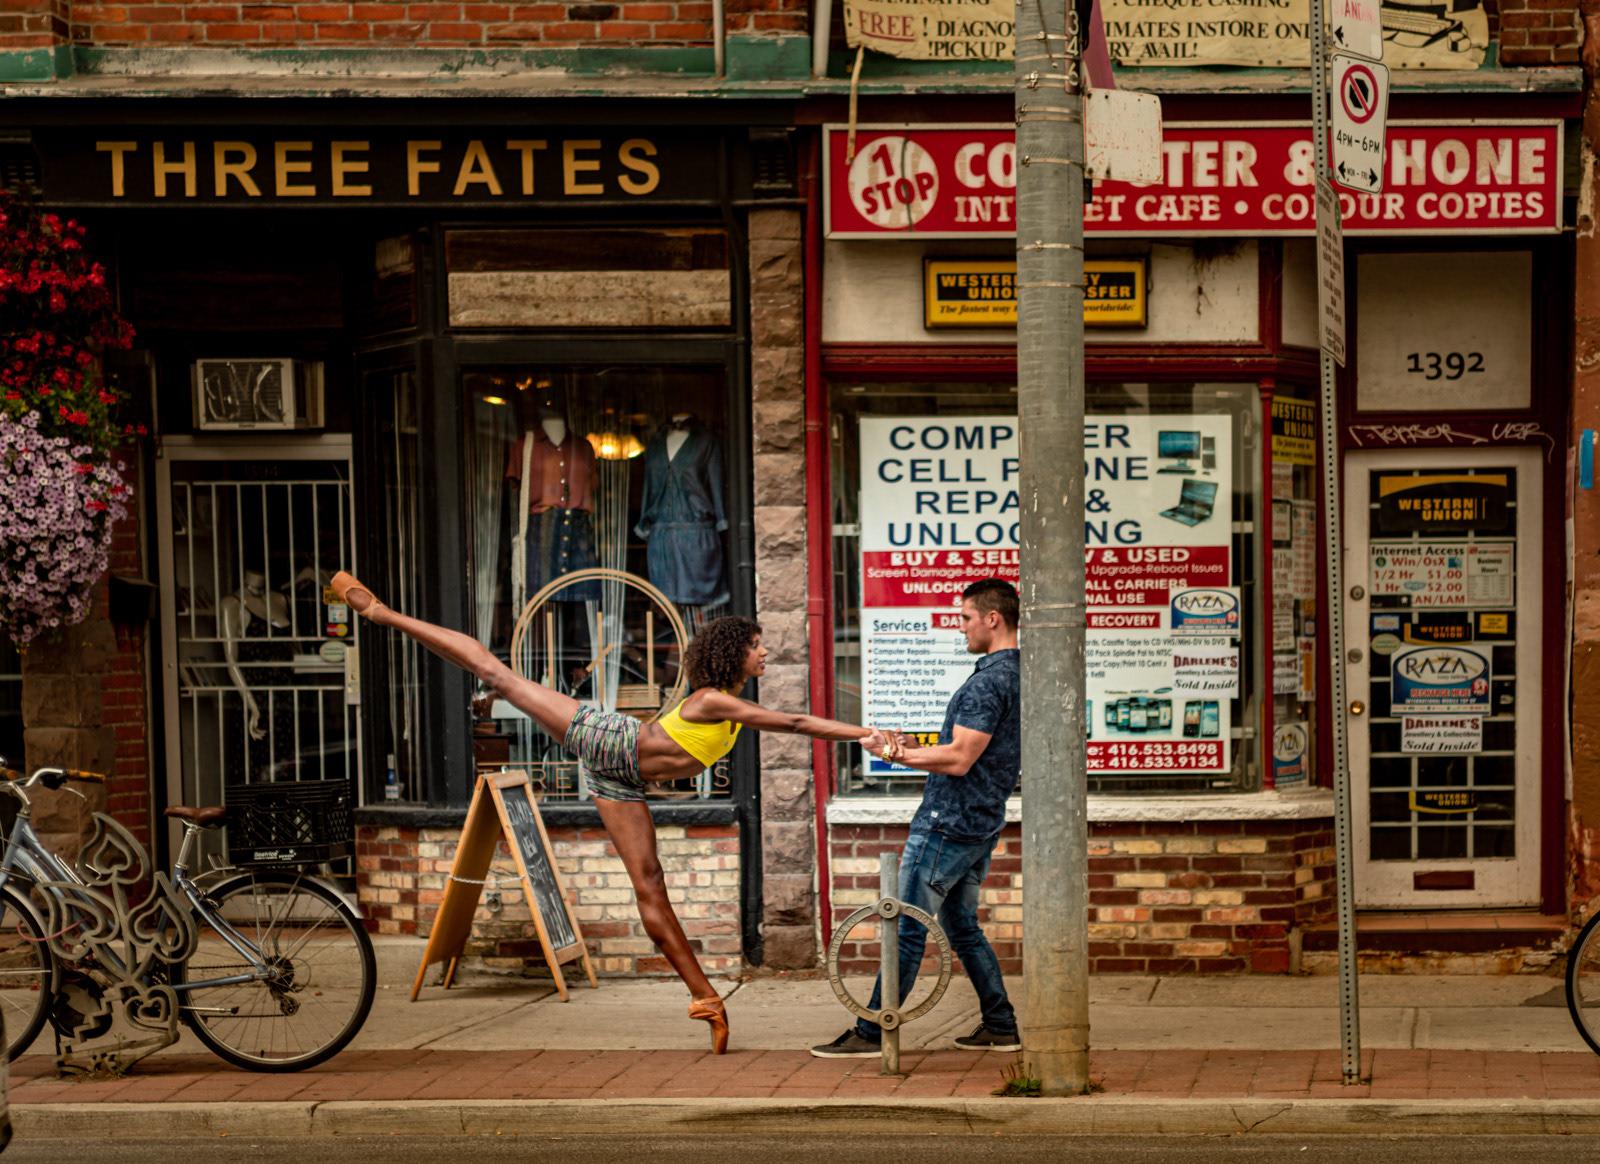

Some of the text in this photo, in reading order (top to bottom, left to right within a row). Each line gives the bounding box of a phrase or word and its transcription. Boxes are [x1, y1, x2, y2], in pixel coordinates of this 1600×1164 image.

[859, 11, 915, 38] FREE
[1187, 21, 1269, 39] INSTORE
[871, 144, 892, 178] 1
[96, 139, 660, 197] THREE FATES
[861, 172, 934, 215] STOP
[1134, 195, 1220, 222] CAFE
[1416, 192, 1545, 220] COPIES
[1407, 352, 1485, 380] 1392
[878, 458, 987, 483] CELL
[1085, 489, 1111, 513] &
[1398, 498, 1474, 511] WESTERN
[1422, 509, 1474, 521] UNION
[891, 552, 939, 566] BUY
[946, 551, 964, 565] &
[1101, 550, 1119, 563] &
[1127, 548, 1190, 563] USED
[1371, 547, 1422, 556] Internet
[1425, 546, 1465, 556] Access
[867, 567, 908, 578] Screen
[1191, 562, 1224, 573] Issues
[1374, 570, 1395, 581] 1/2
[1399, 570, 1414, 580] Hr
[1114, 578, 1188, 593] CARRIERS
[1385, 583, 1399, 593] Hr
[1116, 593, 1145, 604] USE
[1180, 596, 1224, 611] RAZA
[873, 620, 928, 632] Services
[1091, 615, 1156, 627] RECOVERY
[1420, 626, 1463, 634] WESTERN
[873, 648, 906, 656] Computer
[873, 658, 906, 667] Computer
[1173, 655, 1238, 668] DARLENE'S
[1405, 657, 1468, 678] RAZA
[1174, 679, 1199, 690] Sold
[1410, 688, 1471, 698] RECHARGE HERE
[1405, 717, 1479, 730] DARLENE'S
[1107, 743, 1217, 756] 416.533.8498
[1405, 739, 1478, 752] Sold Inside
[1108, 756, 1218, 769] 416.533.9134
